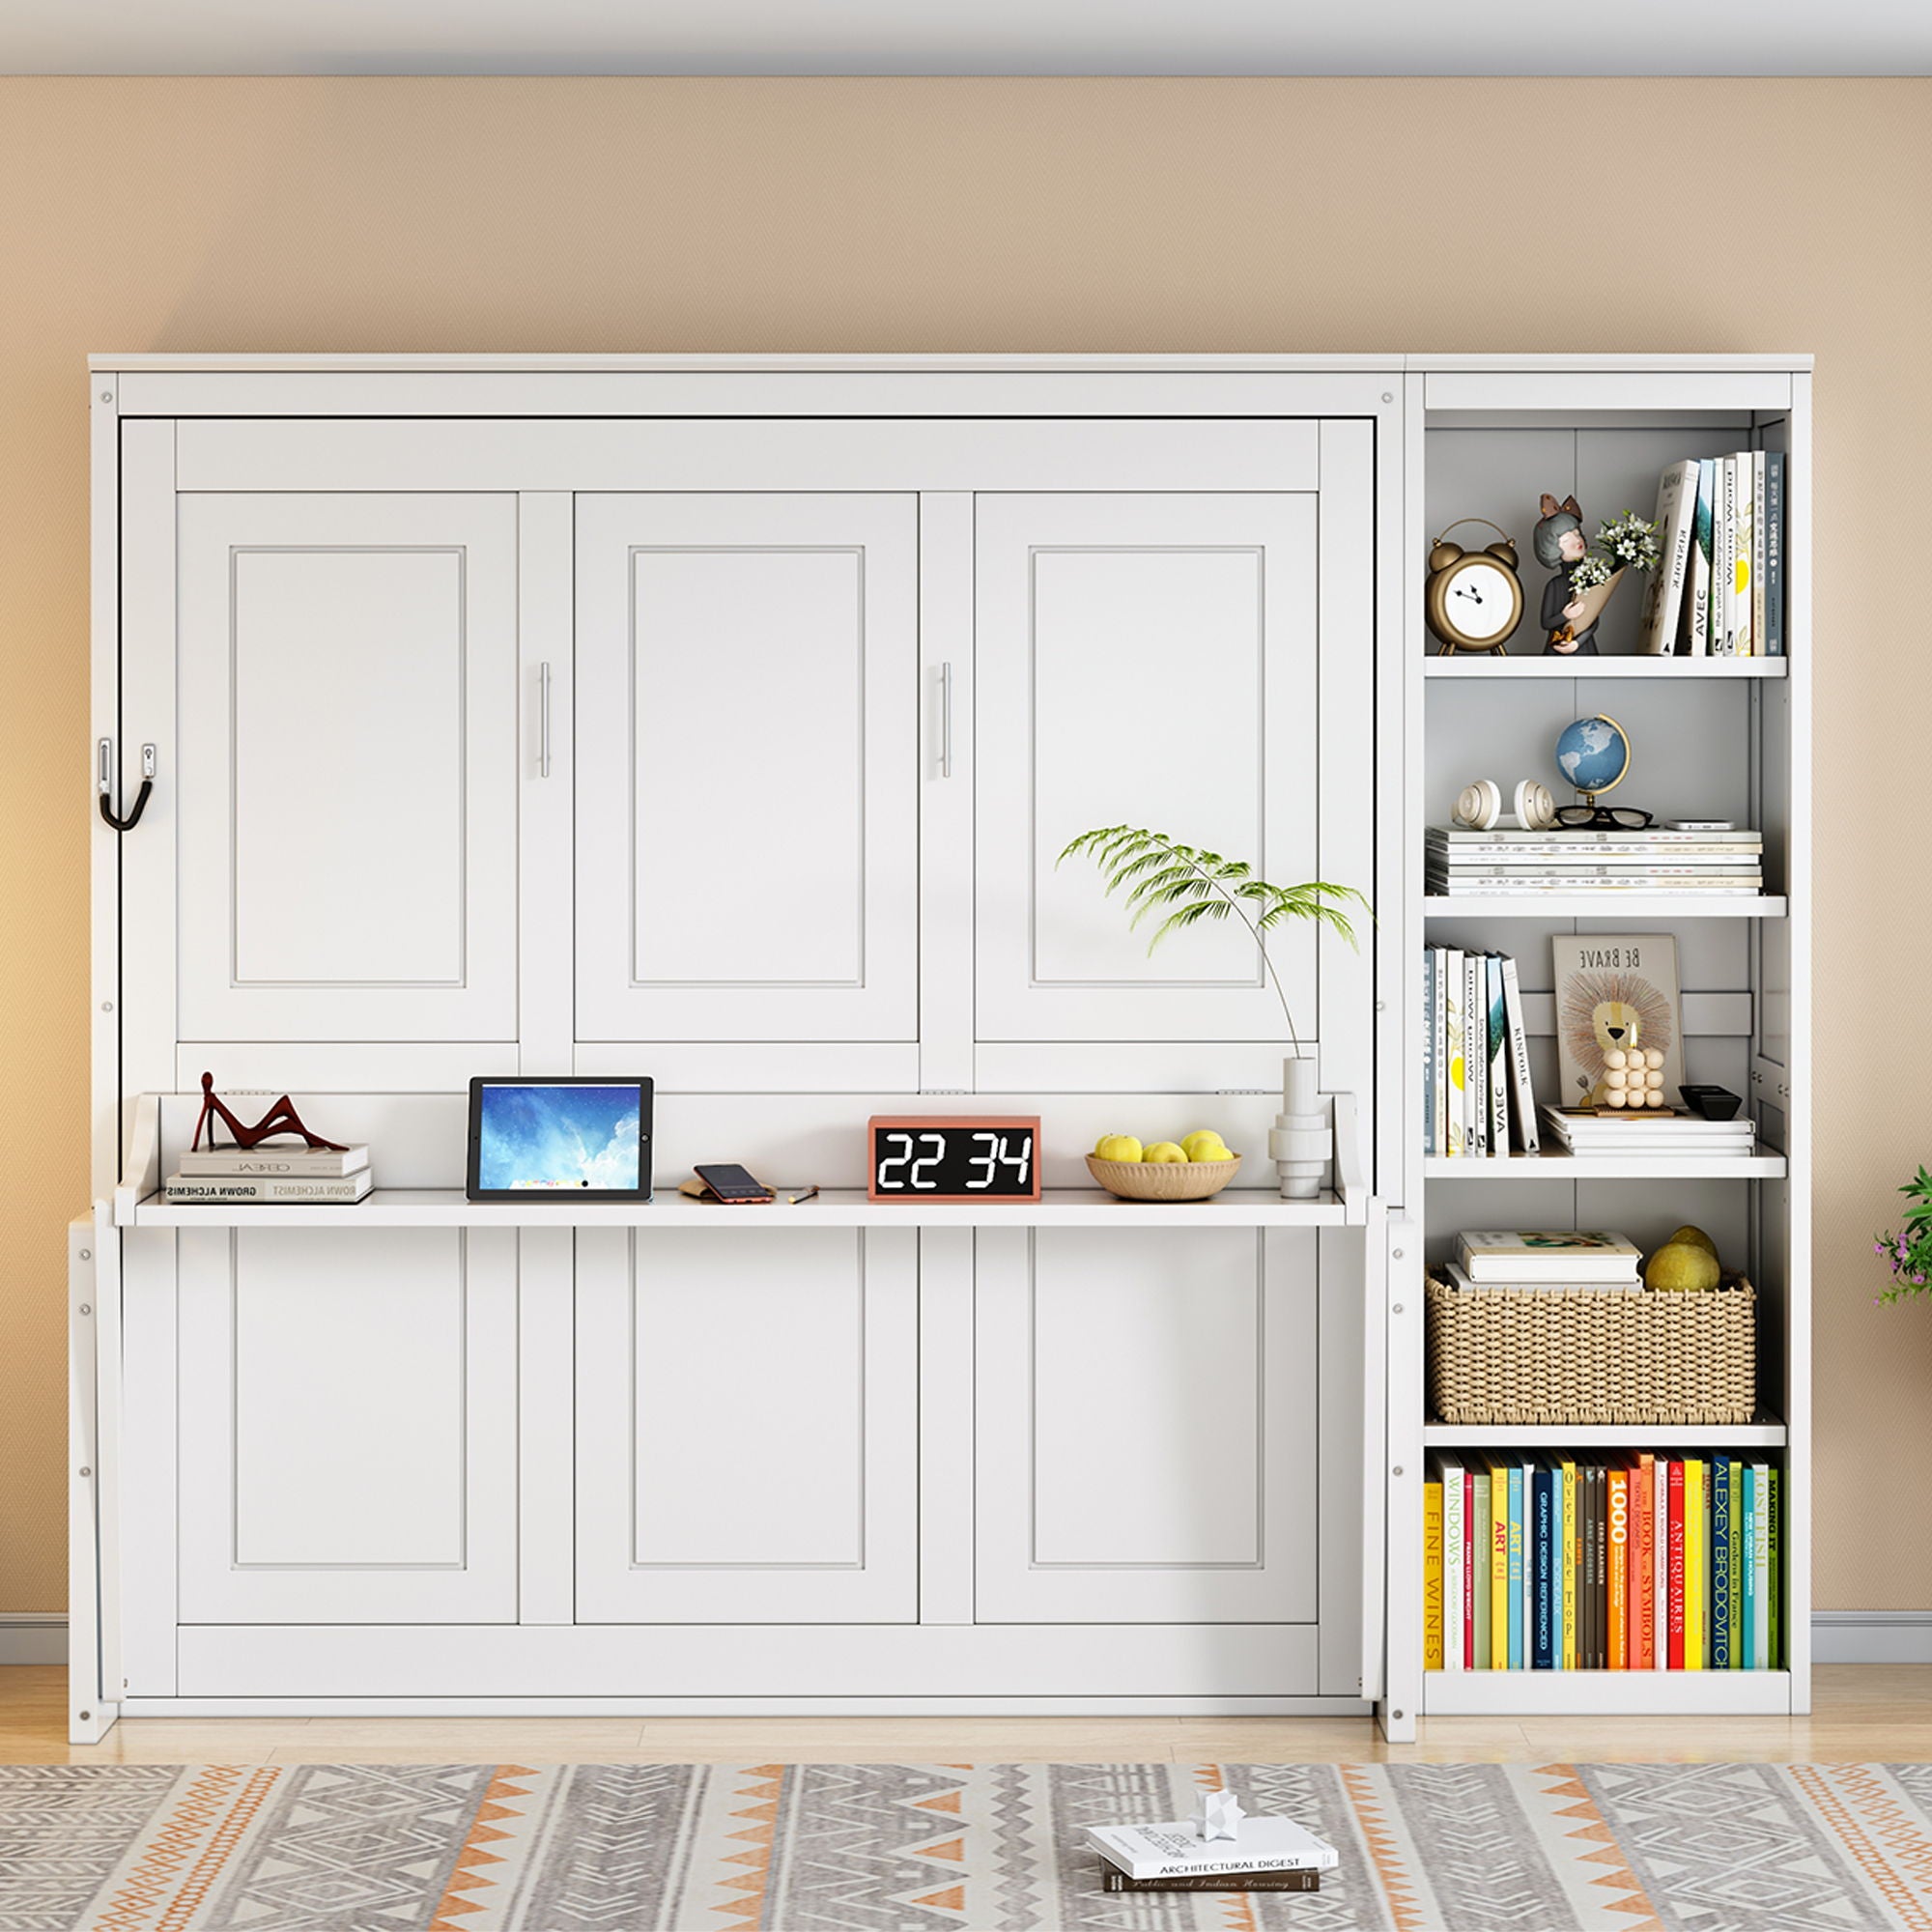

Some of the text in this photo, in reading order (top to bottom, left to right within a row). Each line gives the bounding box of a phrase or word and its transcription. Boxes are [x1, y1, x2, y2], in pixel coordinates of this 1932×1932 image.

[1726, 471, 1735, 523] World
[1695, 589, 1706, 637] AVEC
[1514, 1028, 1528, 1087] KINFOLK
[877, 1133, 1033, 1189] 22 34
[1448, 1476, 1461, 1566] WINDOWS
[1611, 1479, 1627, 1544] 1000
[1754, 1471, 1766, 1519] LOST
[1427, 1512, 1439, 1566] FINE
[1495, 1520, 1506, 1555] ART
[1510, 1520, 1521, 1555] ART
[1641, 1511, 1652, 1556] BOOK
[1769, 1535, 1776, 1551] IT
[1673, 1520, 1683, 1634] ANTIQUAIRES
[1715, 1462, 1728, 1669] ALEXEY BRODOVITCH
[1730, 1531, 1740, 1629] Gardens in France
[1427, 1577, 1439, 1660] WINES
[1641, 1575, 1652, 1658] SYMBOLS
[1159, 1857, 1301, 1875] ARCHITECTURAL DIGEST
[1171, 1880, 1195, 1889] and
